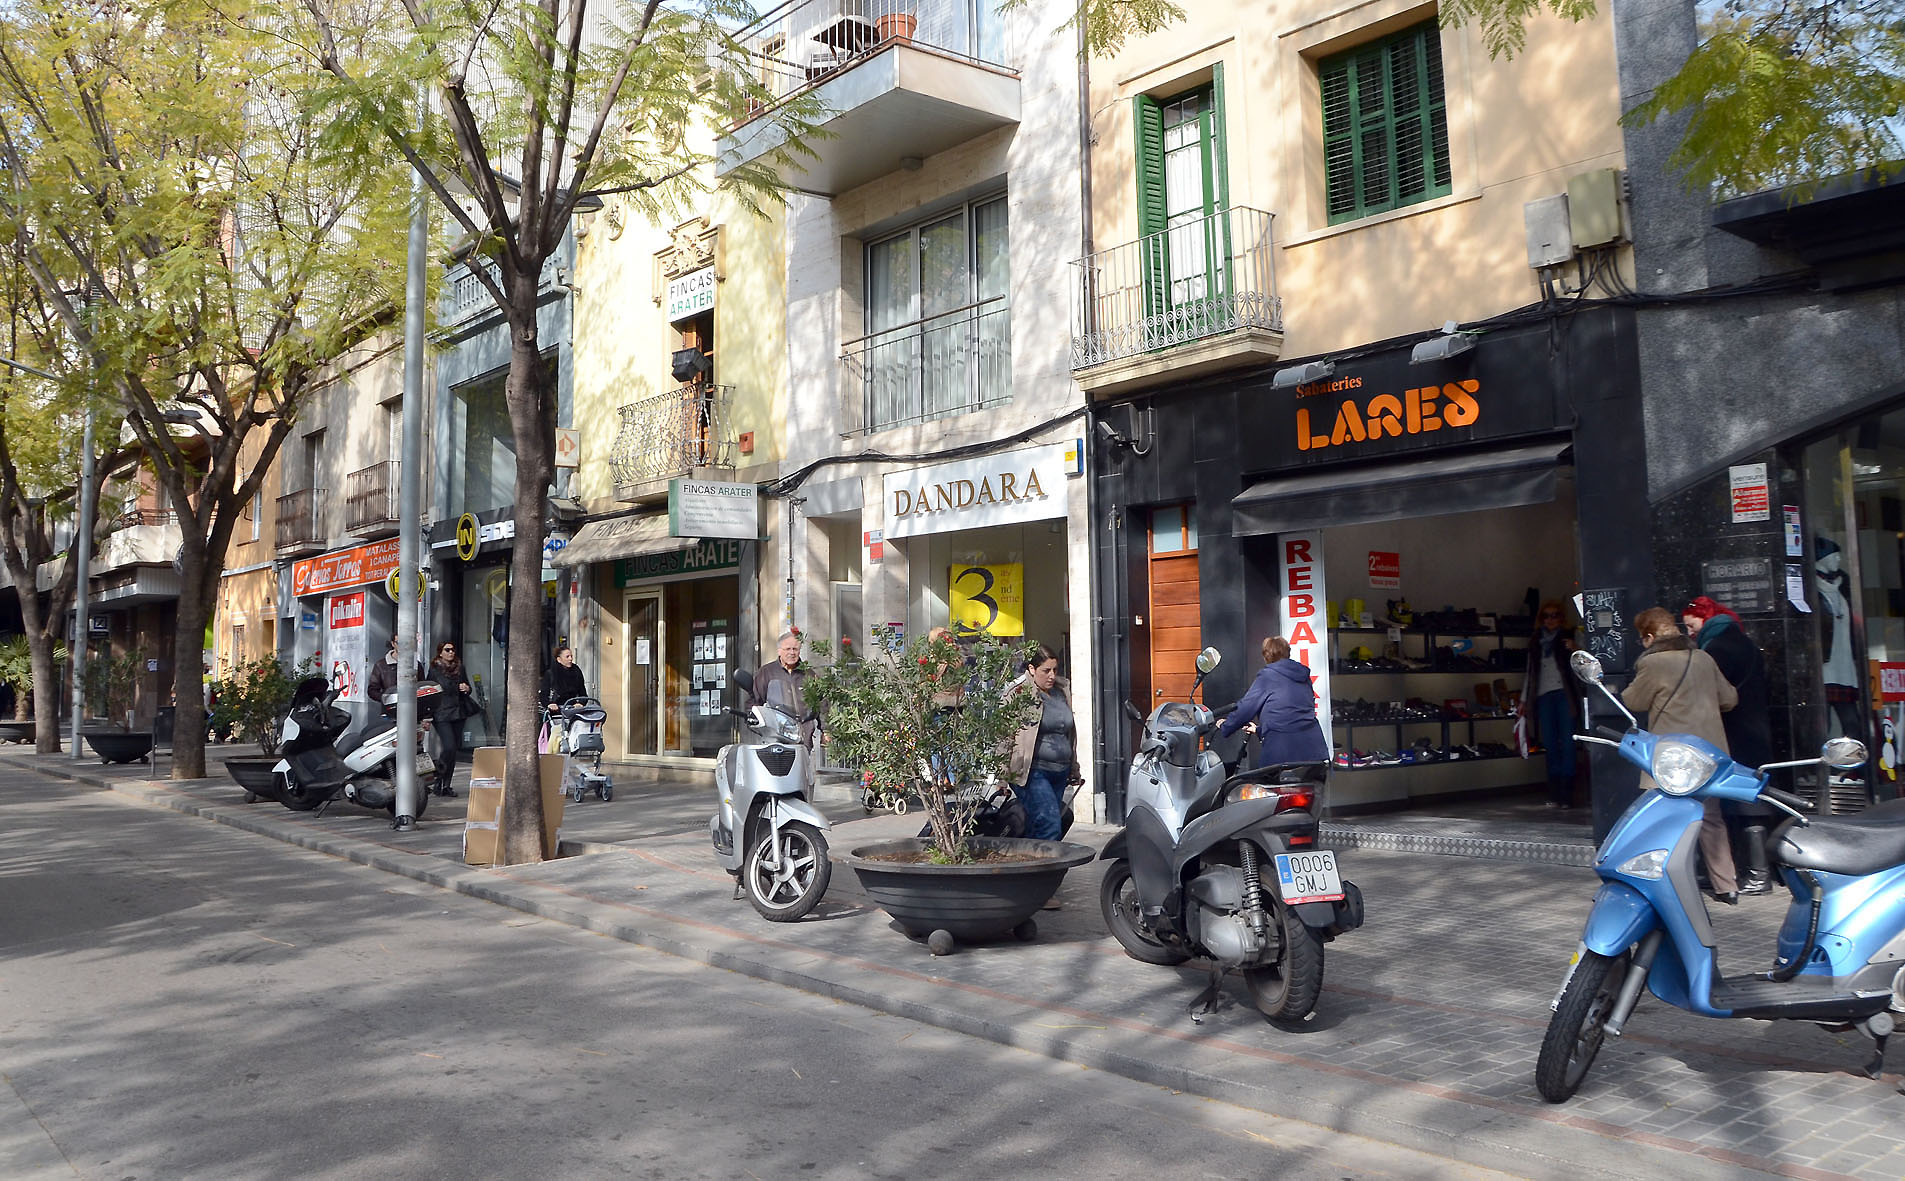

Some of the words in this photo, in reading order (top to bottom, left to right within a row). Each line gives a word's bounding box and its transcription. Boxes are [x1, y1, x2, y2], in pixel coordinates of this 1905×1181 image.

[671, 272, 713, 299] FINCAS
[670, 290, 713, 316] ARATER
[1296, 376, 1362, 399] Sabateries
[1296, 379, 1480, 450] LARES
[683, 484, 716, 495] FINCAS
[718, 487, 752, 497] ARATER
[894, 468, 1045, 516] DANDARA
[625, 552, 680, 576] FINCAS
[1709, 563, 1766, 578] HORARIO
[955, 567, 998, 633] 3
[1291, 855, 1333, 873] 0006
[1295, 874, 1327, 893] GMJ
